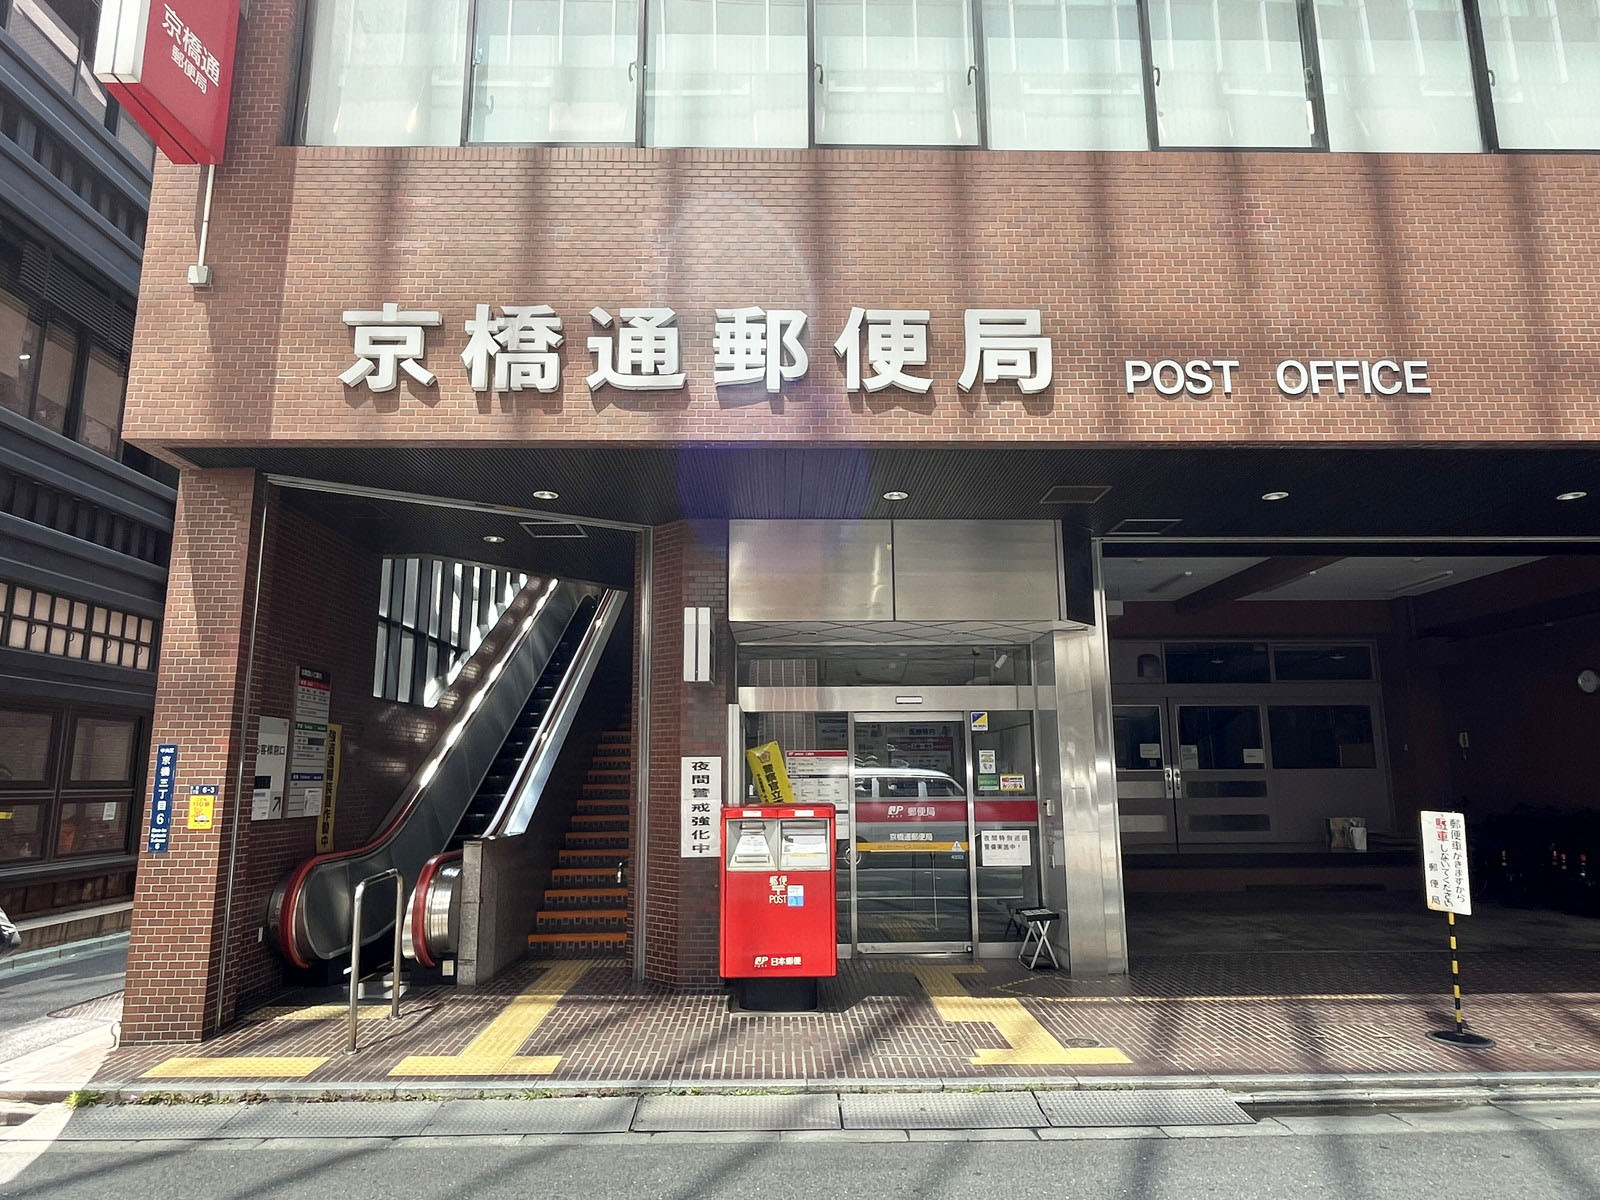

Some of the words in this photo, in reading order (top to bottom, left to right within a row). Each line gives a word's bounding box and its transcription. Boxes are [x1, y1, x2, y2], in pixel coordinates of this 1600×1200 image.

[162, 3, 220, 87] 京橋通
[171, 45, 207, 94] 郵便局
[337, 302, 1053, 393] 京橋通郵便局
[1125, 360, 1240, 396] POST
[1276, 360, 1432, 396] OFFICE
[202, 786, 215, 794] 6-3
[691, 761, 710, 854] 夜間警戒強化中
[908, 807, 935, 816] 郵便局
[889, 833, 933, 841] 京橋通郵便局
[769, 875, 788, 886] 郵便
[1428, 863, 1441, 905] 郵便局
[769, 894, 788, 904] POST
[771, 956, 802, 966] 日本郵便
